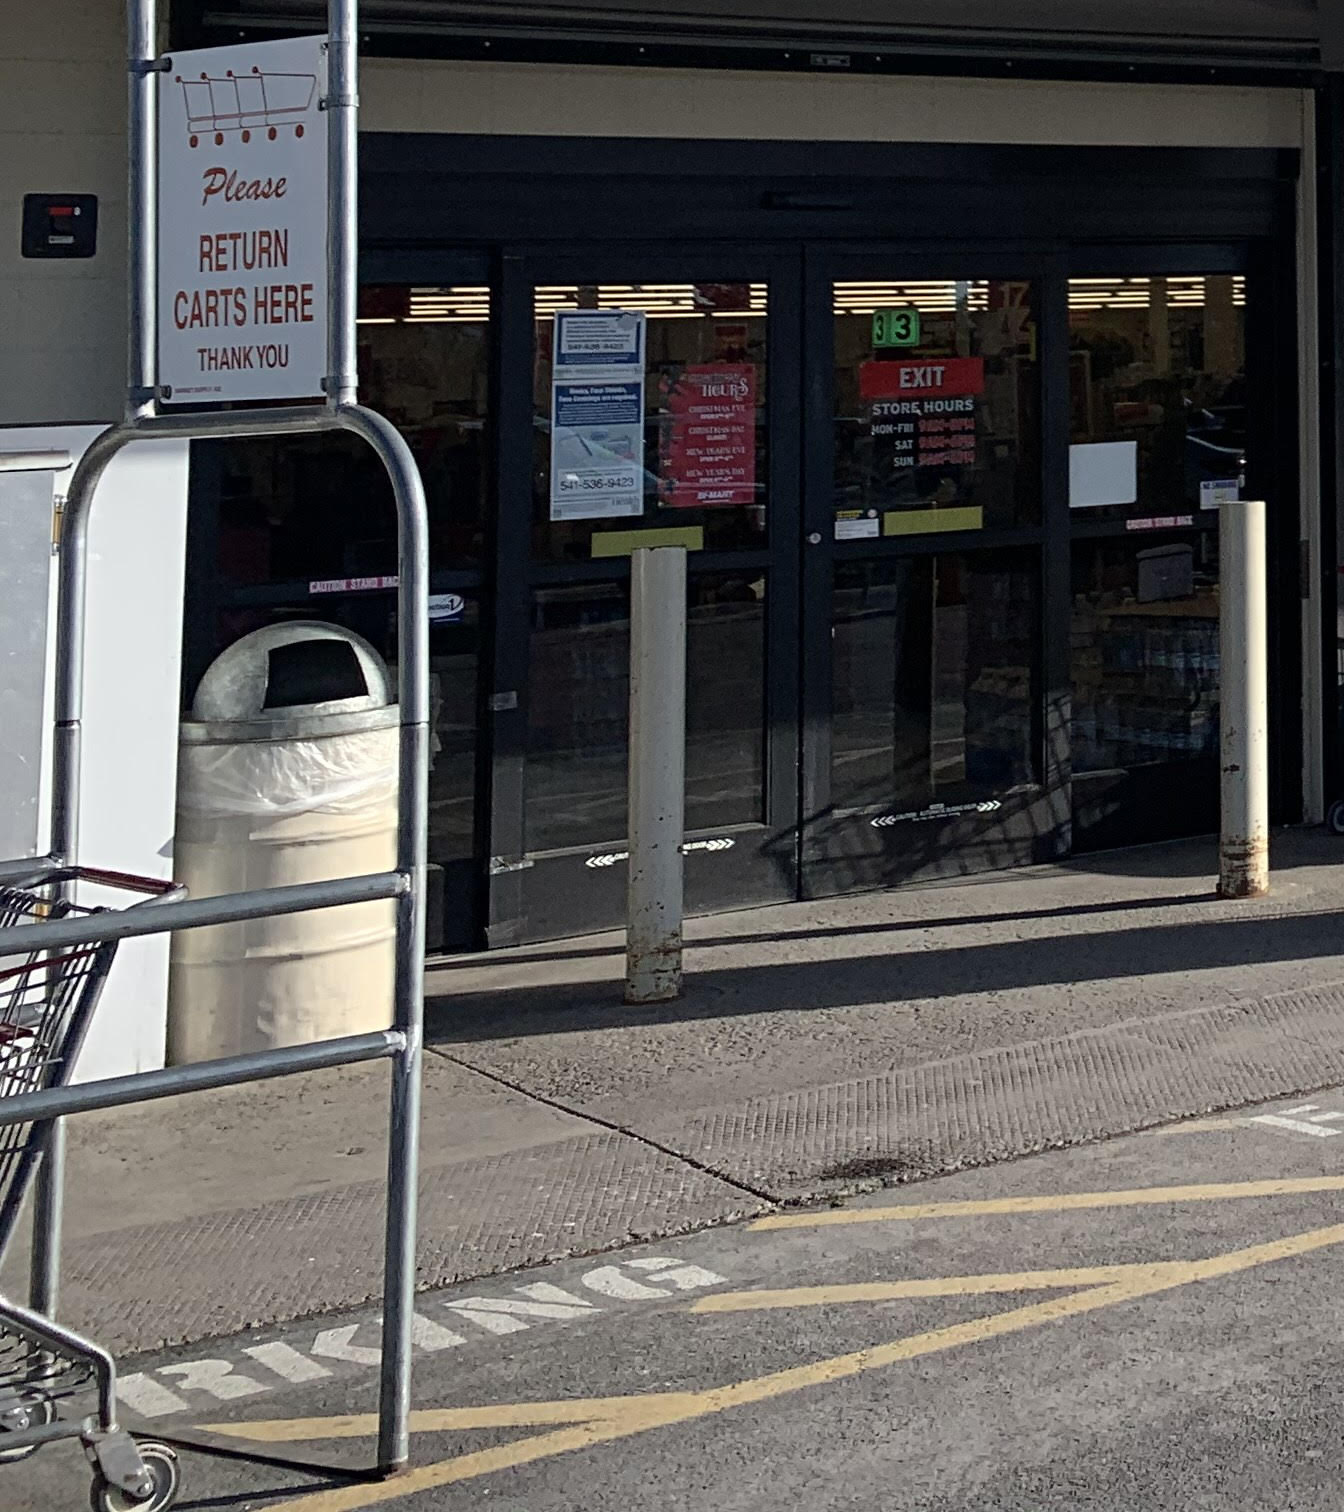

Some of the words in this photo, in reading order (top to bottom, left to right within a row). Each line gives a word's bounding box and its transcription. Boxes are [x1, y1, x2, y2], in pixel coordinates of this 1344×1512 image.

[202, 167, 287, 207] Please
[200, 229, 288, 272] RETURN
[174, 287, 247, 329] CARTS
[254, 284, 313, 325] HERE
[876, 314, 885, 342] 3
[895, 313, 912, 340] 3
[197, 346, 253, 371] THANK
[257, 344, 289, 368] YOU
[900, 366, 945, 388] EXIT
[872, 402, 920, 415] STORE
[924, 399, 974, 413] HOURS
[894, 440, 914, 450] SAT
[893, 457, 914, 467] SUN
[310, 580, 346, 593] CAUTION
[351, 577, 377, 590] STAND
[383, 575, 400, 588] BAC
[115, 1257, 728, 1419] RKING
